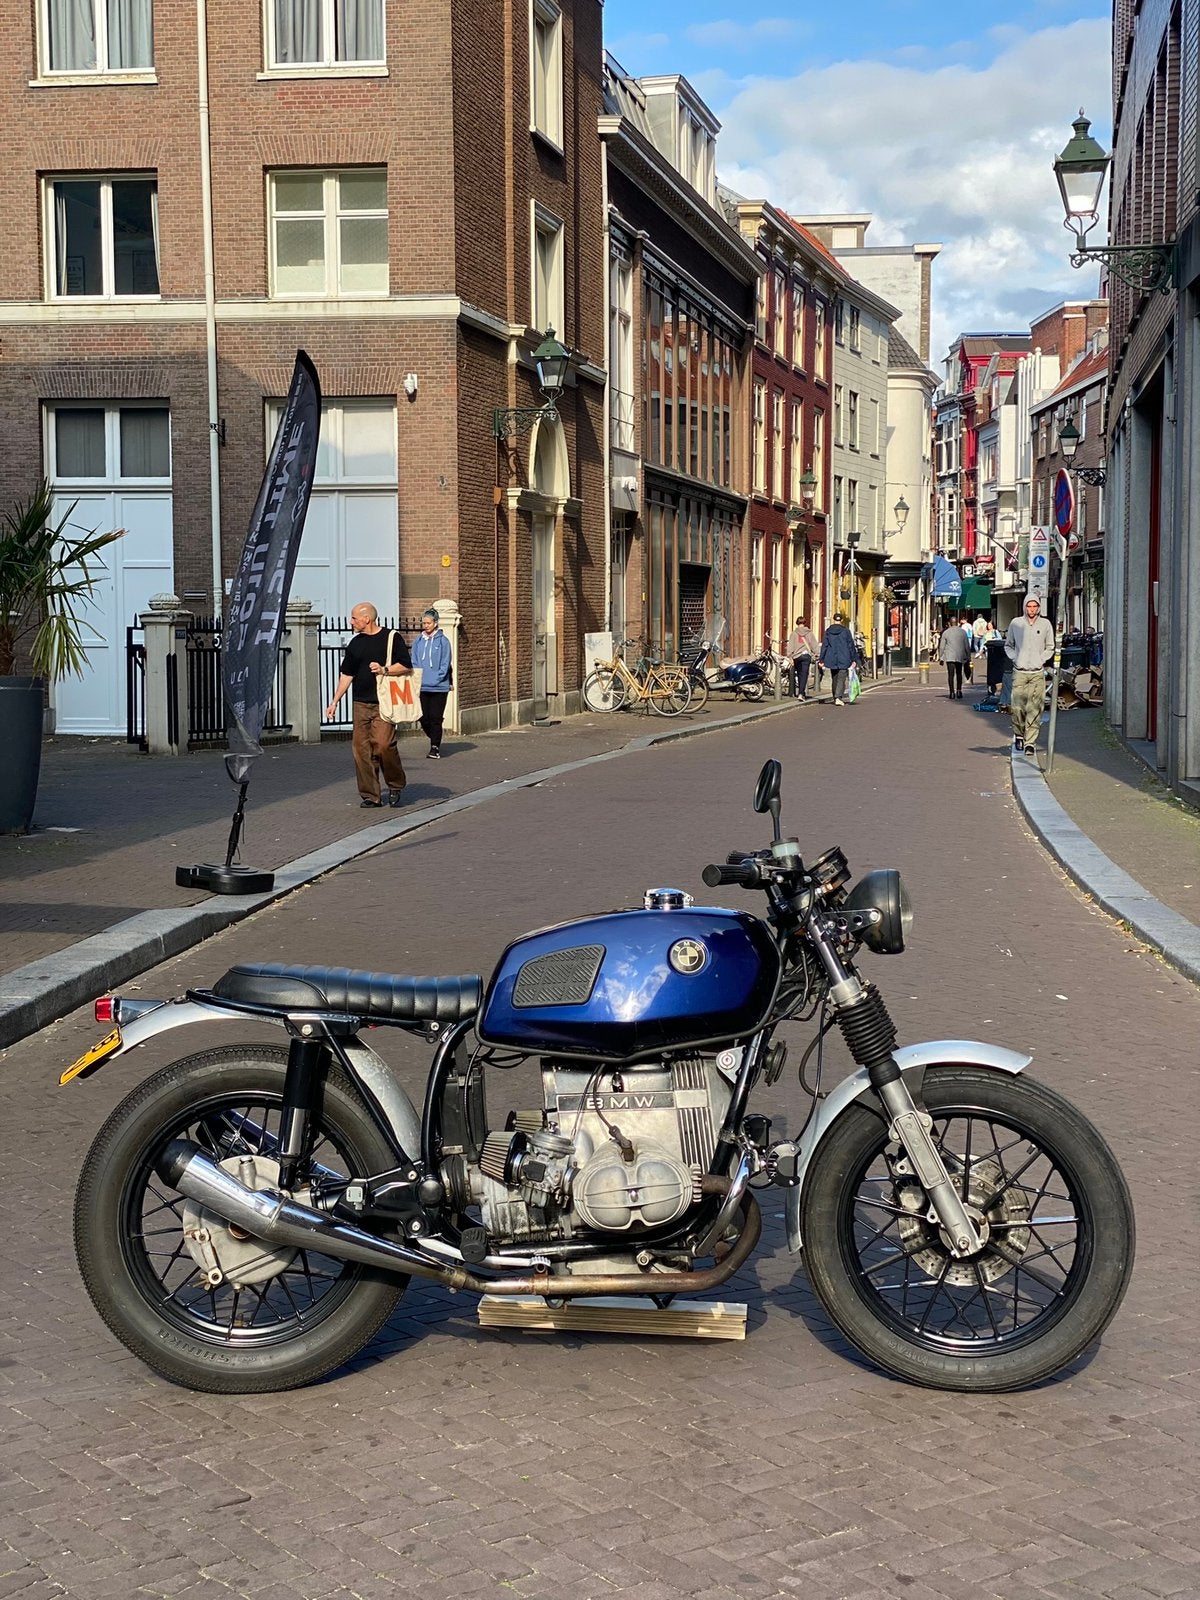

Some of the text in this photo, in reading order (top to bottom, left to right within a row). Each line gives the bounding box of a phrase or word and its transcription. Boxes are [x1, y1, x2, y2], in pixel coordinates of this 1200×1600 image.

[389, 679, 414, 706] M
[674, 941, 704, 953] BMW
[586, 1095, 655, 1110] BMW
